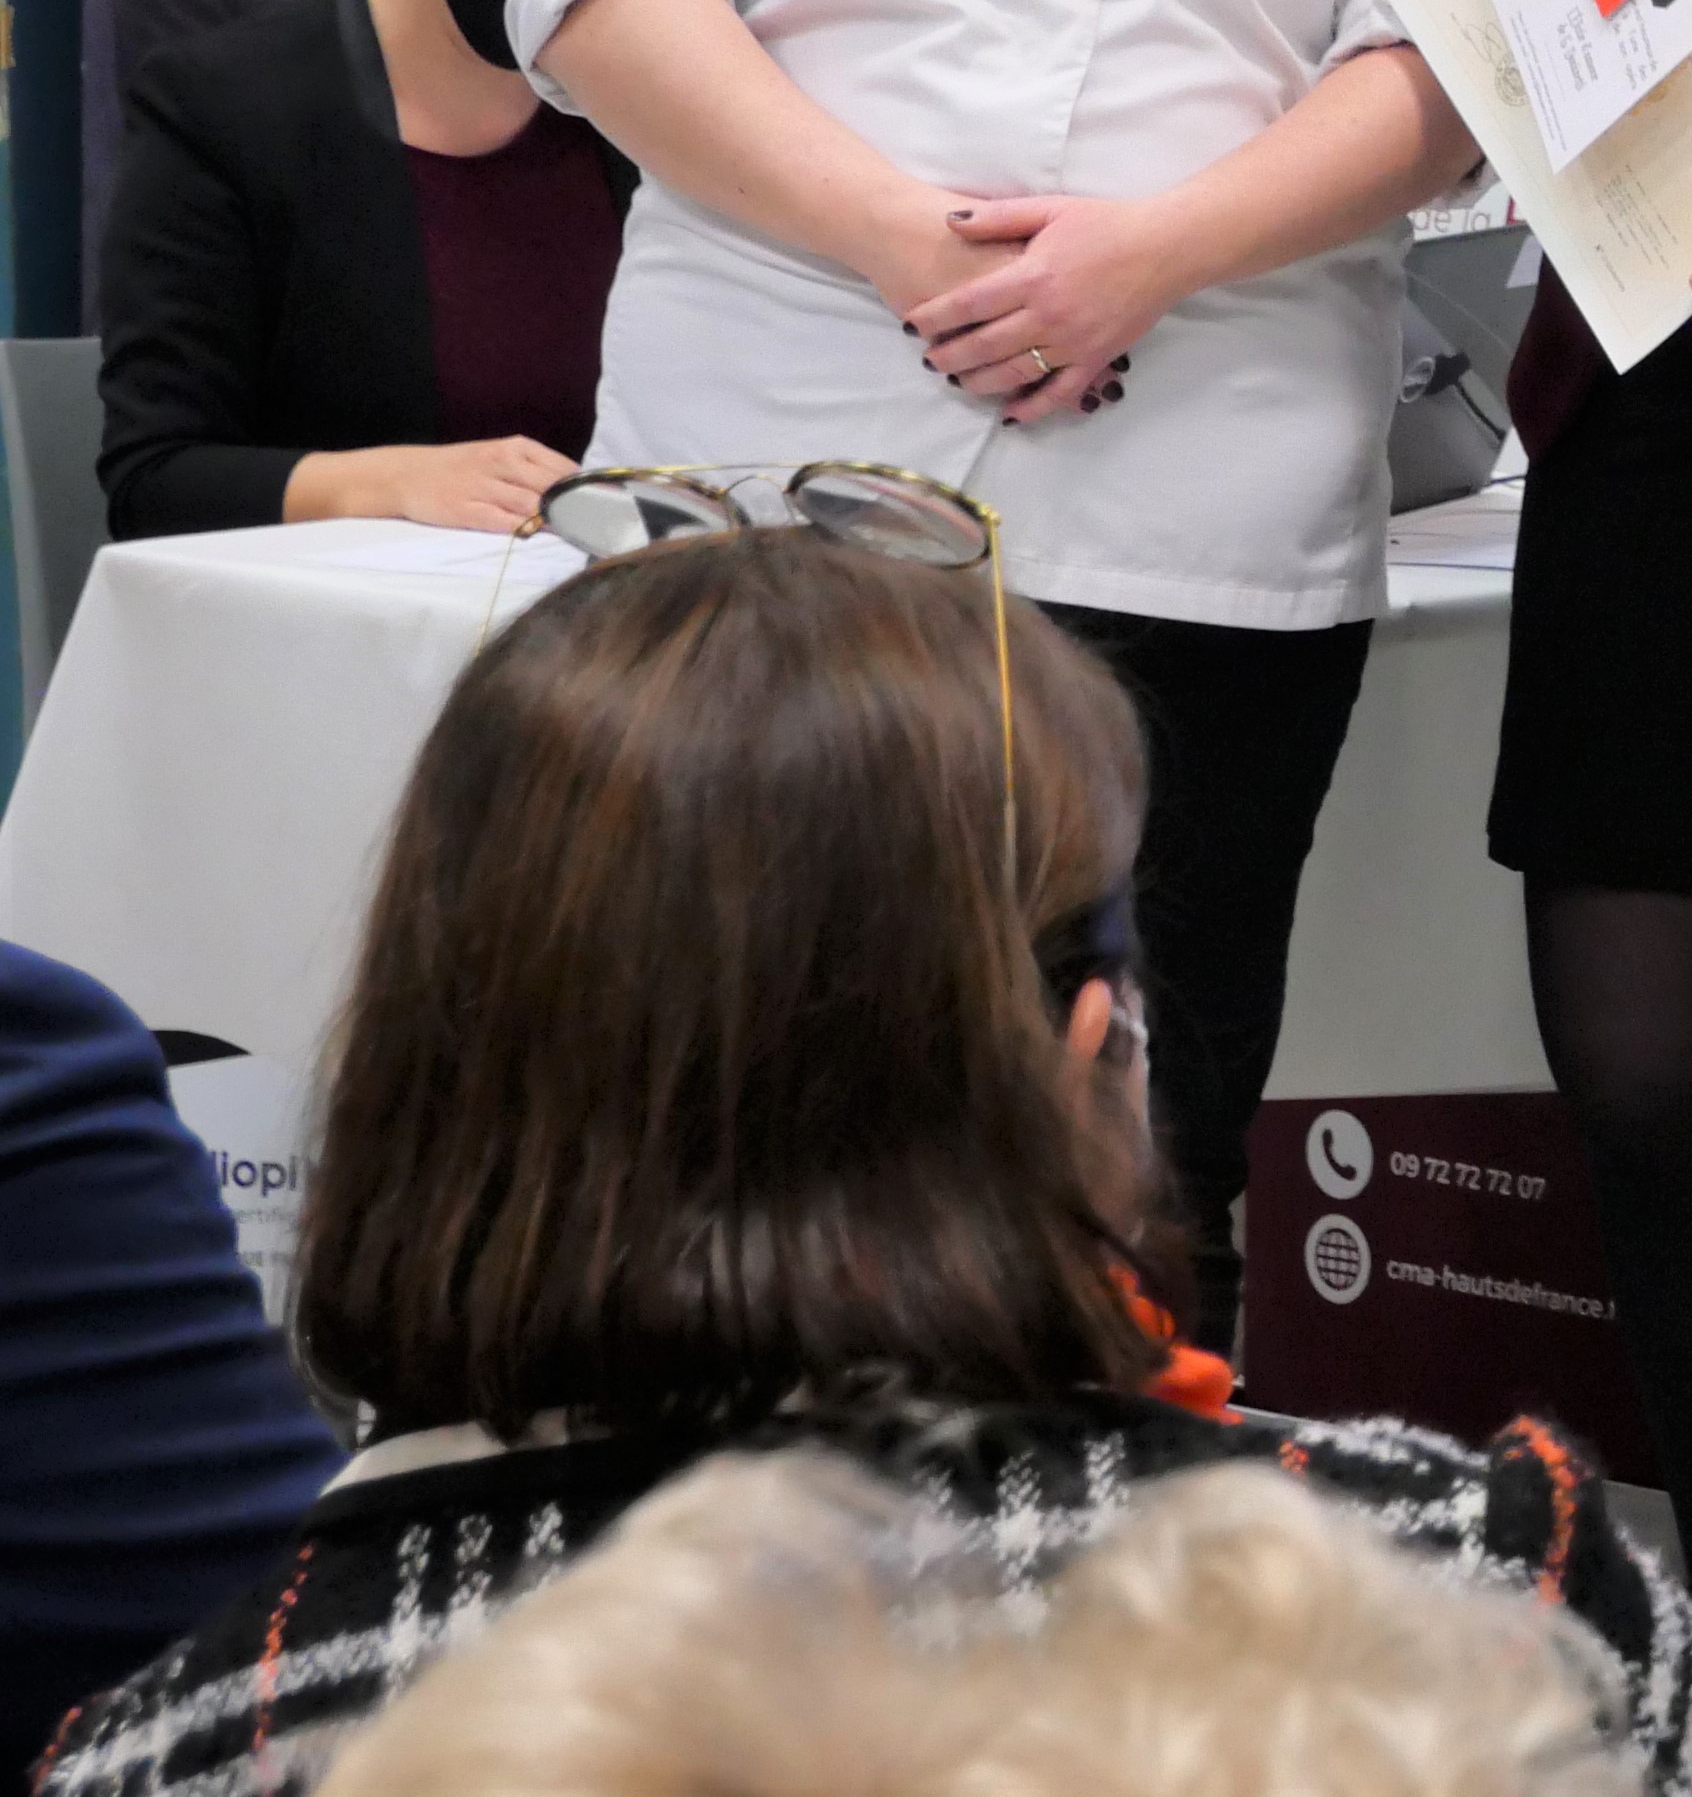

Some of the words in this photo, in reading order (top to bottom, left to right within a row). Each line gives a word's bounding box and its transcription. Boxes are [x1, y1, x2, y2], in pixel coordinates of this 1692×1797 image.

[1389, 1151, 1421, 1179] 09
[1423, 1156, 1451, 1185] 72
[1454, 1162, 1481, 1191] 72
[1485, 1167, 1513, 1196] 72
[1517, 1174, 1547, 1200] 07
